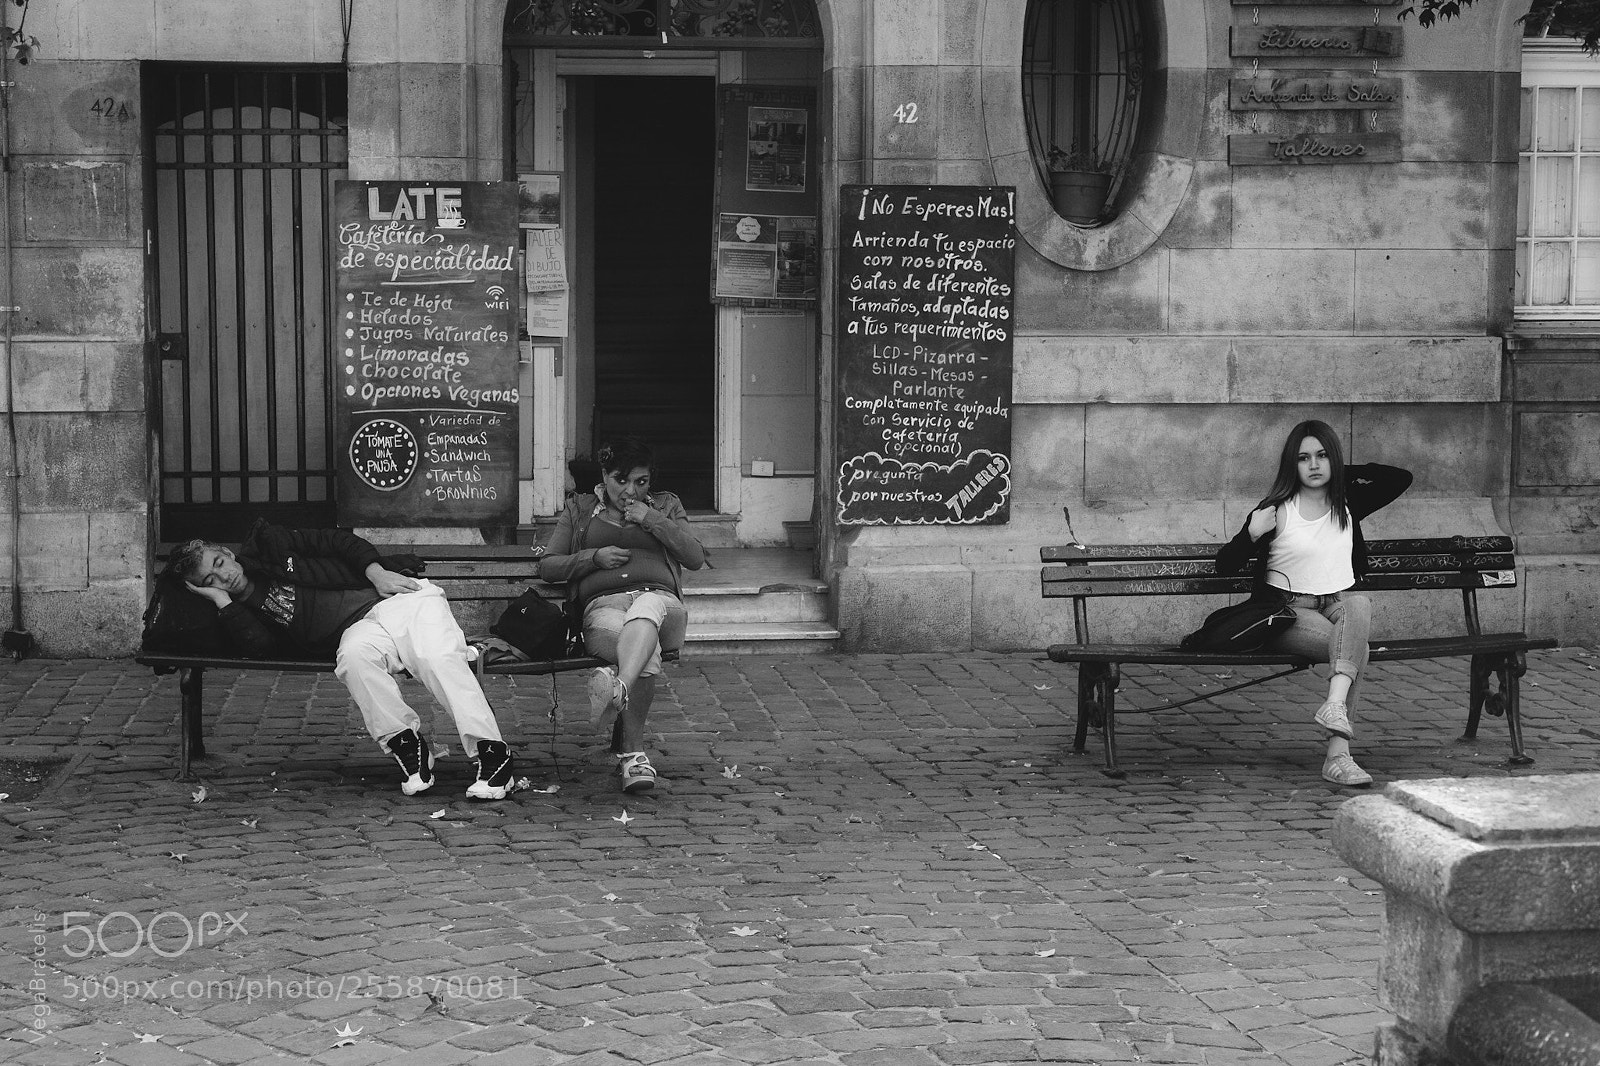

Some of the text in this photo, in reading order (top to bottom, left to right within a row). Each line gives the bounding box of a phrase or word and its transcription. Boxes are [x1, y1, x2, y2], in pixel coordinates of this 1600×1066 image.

[1321, 83, 1339, 101] de
[90, 97, 129, 119] 42A
[893, 102, 918, 123] 42
[1268, 137, 1367, 157] Talleres
[368, 187, 462, 220] LATE
[901, 196, 975, 222] Esperes
[977, 192, 1016, 226] Mas!
[339, 221, 445, 251] Cafetería
[527, 230, 562, 247] TALLER
[852, 230, 1015, 260] Arrienda tu espacio
[340, 244, 513, 281] de especialidad
[546, 247, 557, 260] DE
[863, 252, 988, 272] con nosotros.
[527, 261, 561, 272] DIBUJO
[850, 271, 1011, 297] Salas de diferentes
[361, 291, 453, 313] Te de Hoja
[922, 296, 1009, 324] adaptadas
[360, 308, 433, 325] Helados
[359, 324, 509, 344] Jugos Naturales
[847, 315, 1007, 342] a tus requerimientos
[360, 344, 469, 366] Limonadas
[873, 344, 900, 360] LCD
[913, 345, 976, 364] Pizarra
[362, 363, 462, 383] Chocolate
[872, 362, 918, 377] Sillas
[931, 368, 975, 382] Mesas
[361, 383, 520, 408] Opciones Veganas
[893, 381, 966, 399] Parlante
[845, 395, 1008, 421] Completamente equipada
[429, 415, 501, 427] Variedad de
[891, 412, 952, 428] Servicio
[958, 416, 975, 431] de
[882, 428, 959, 443] Cafetería
[375, 449, 393, 459] UNA
[430, 449, 491, 463] Sandwich
[367, 460, 398, 473] PAUSA
[848, 468, 924, 485] pregunta
[847, 489, 943, 506] por nuestros
[945, 457, 1006, 519] TALLERES
